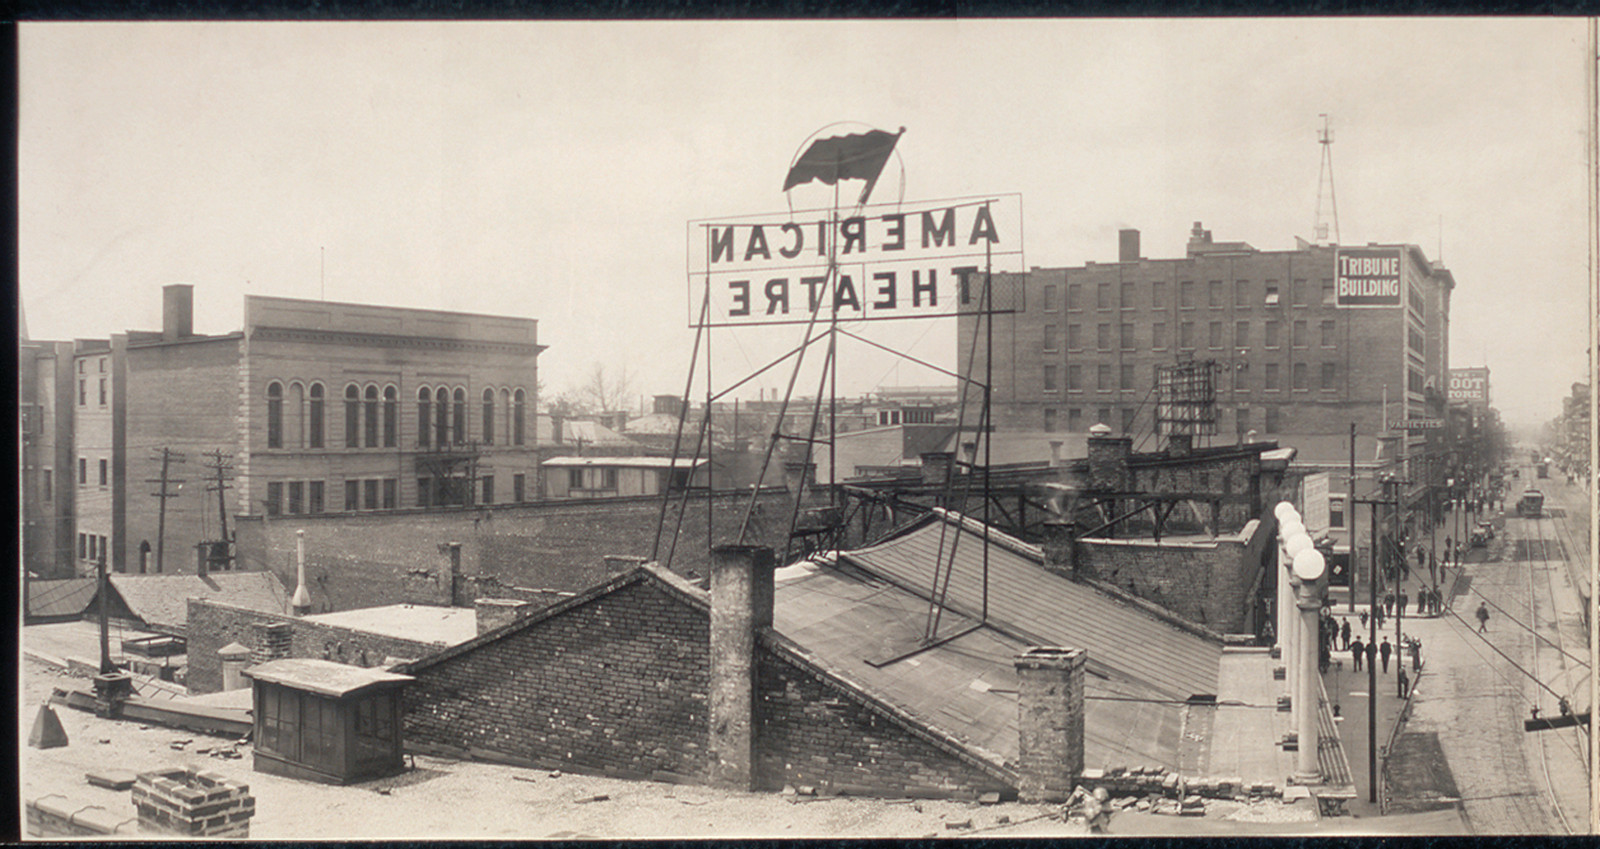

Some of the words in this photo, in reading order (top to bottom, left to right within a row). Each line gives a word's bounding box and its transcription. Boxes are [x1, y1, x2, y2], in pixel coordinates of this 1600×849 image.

[1339, 255, 1399, 276] TRIBUNE
[1339, 277, 1400, 297] BUILDING
[1449, 377, 1485, 390] OOT
[1447, 390, 1482, 399] TORE
[1389, 420, 1443, 430] VARIETIES
